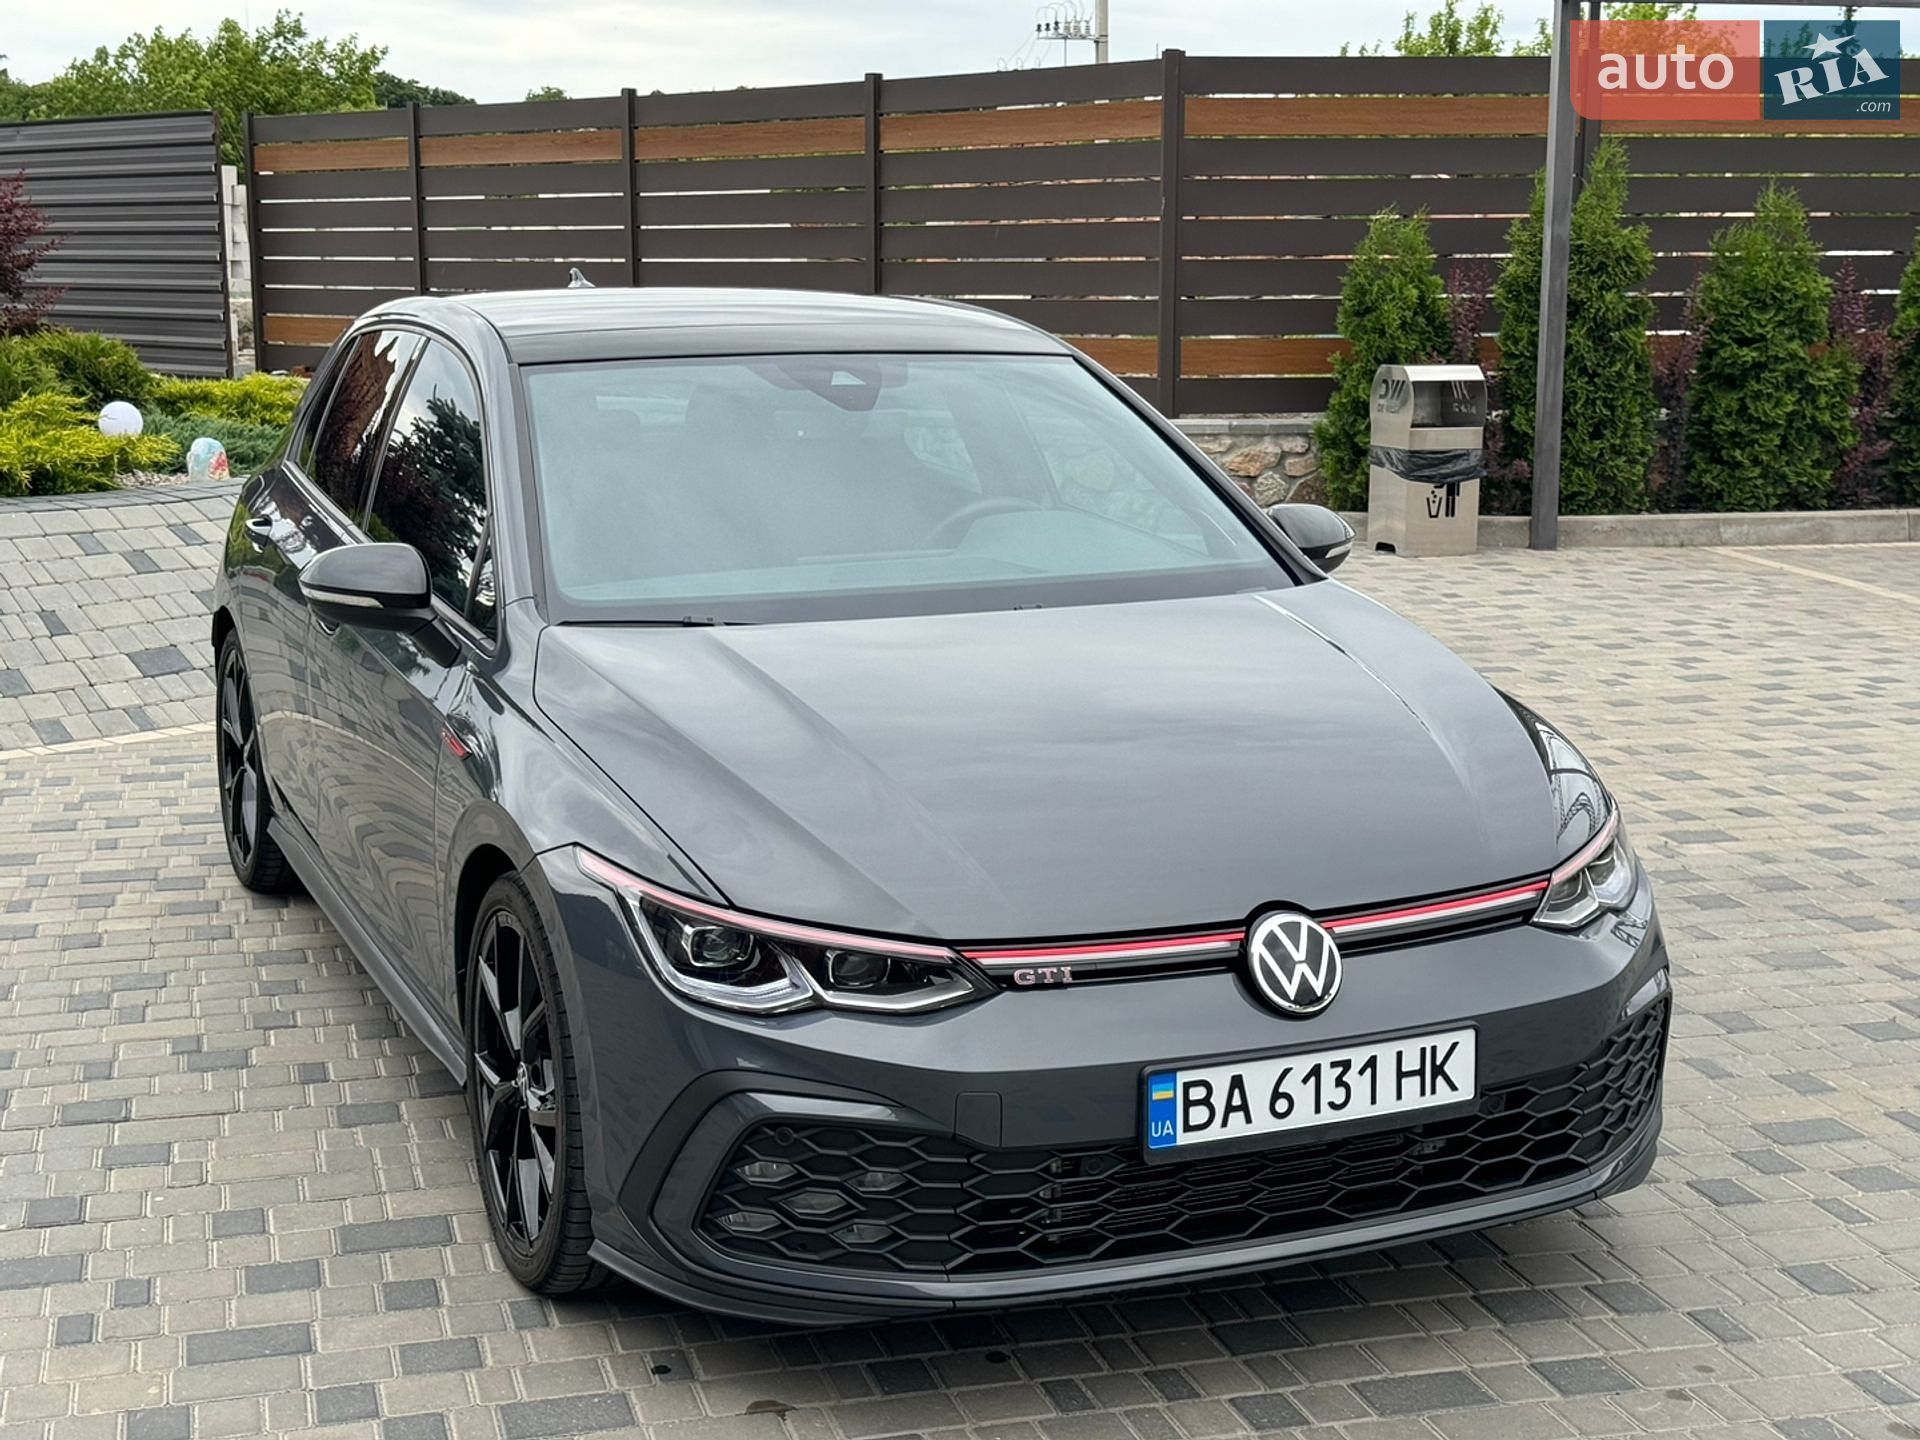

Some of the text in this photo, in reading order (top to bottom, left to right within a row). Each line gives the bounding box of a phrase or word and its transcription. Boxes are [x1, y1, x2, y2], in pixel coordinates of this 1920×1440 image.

[1013, 966, 1073, 986] GTI
[1182, 1041, 1460, 1134] BA 6131 HK
[1151, 1119, 1174, 1138] UA
